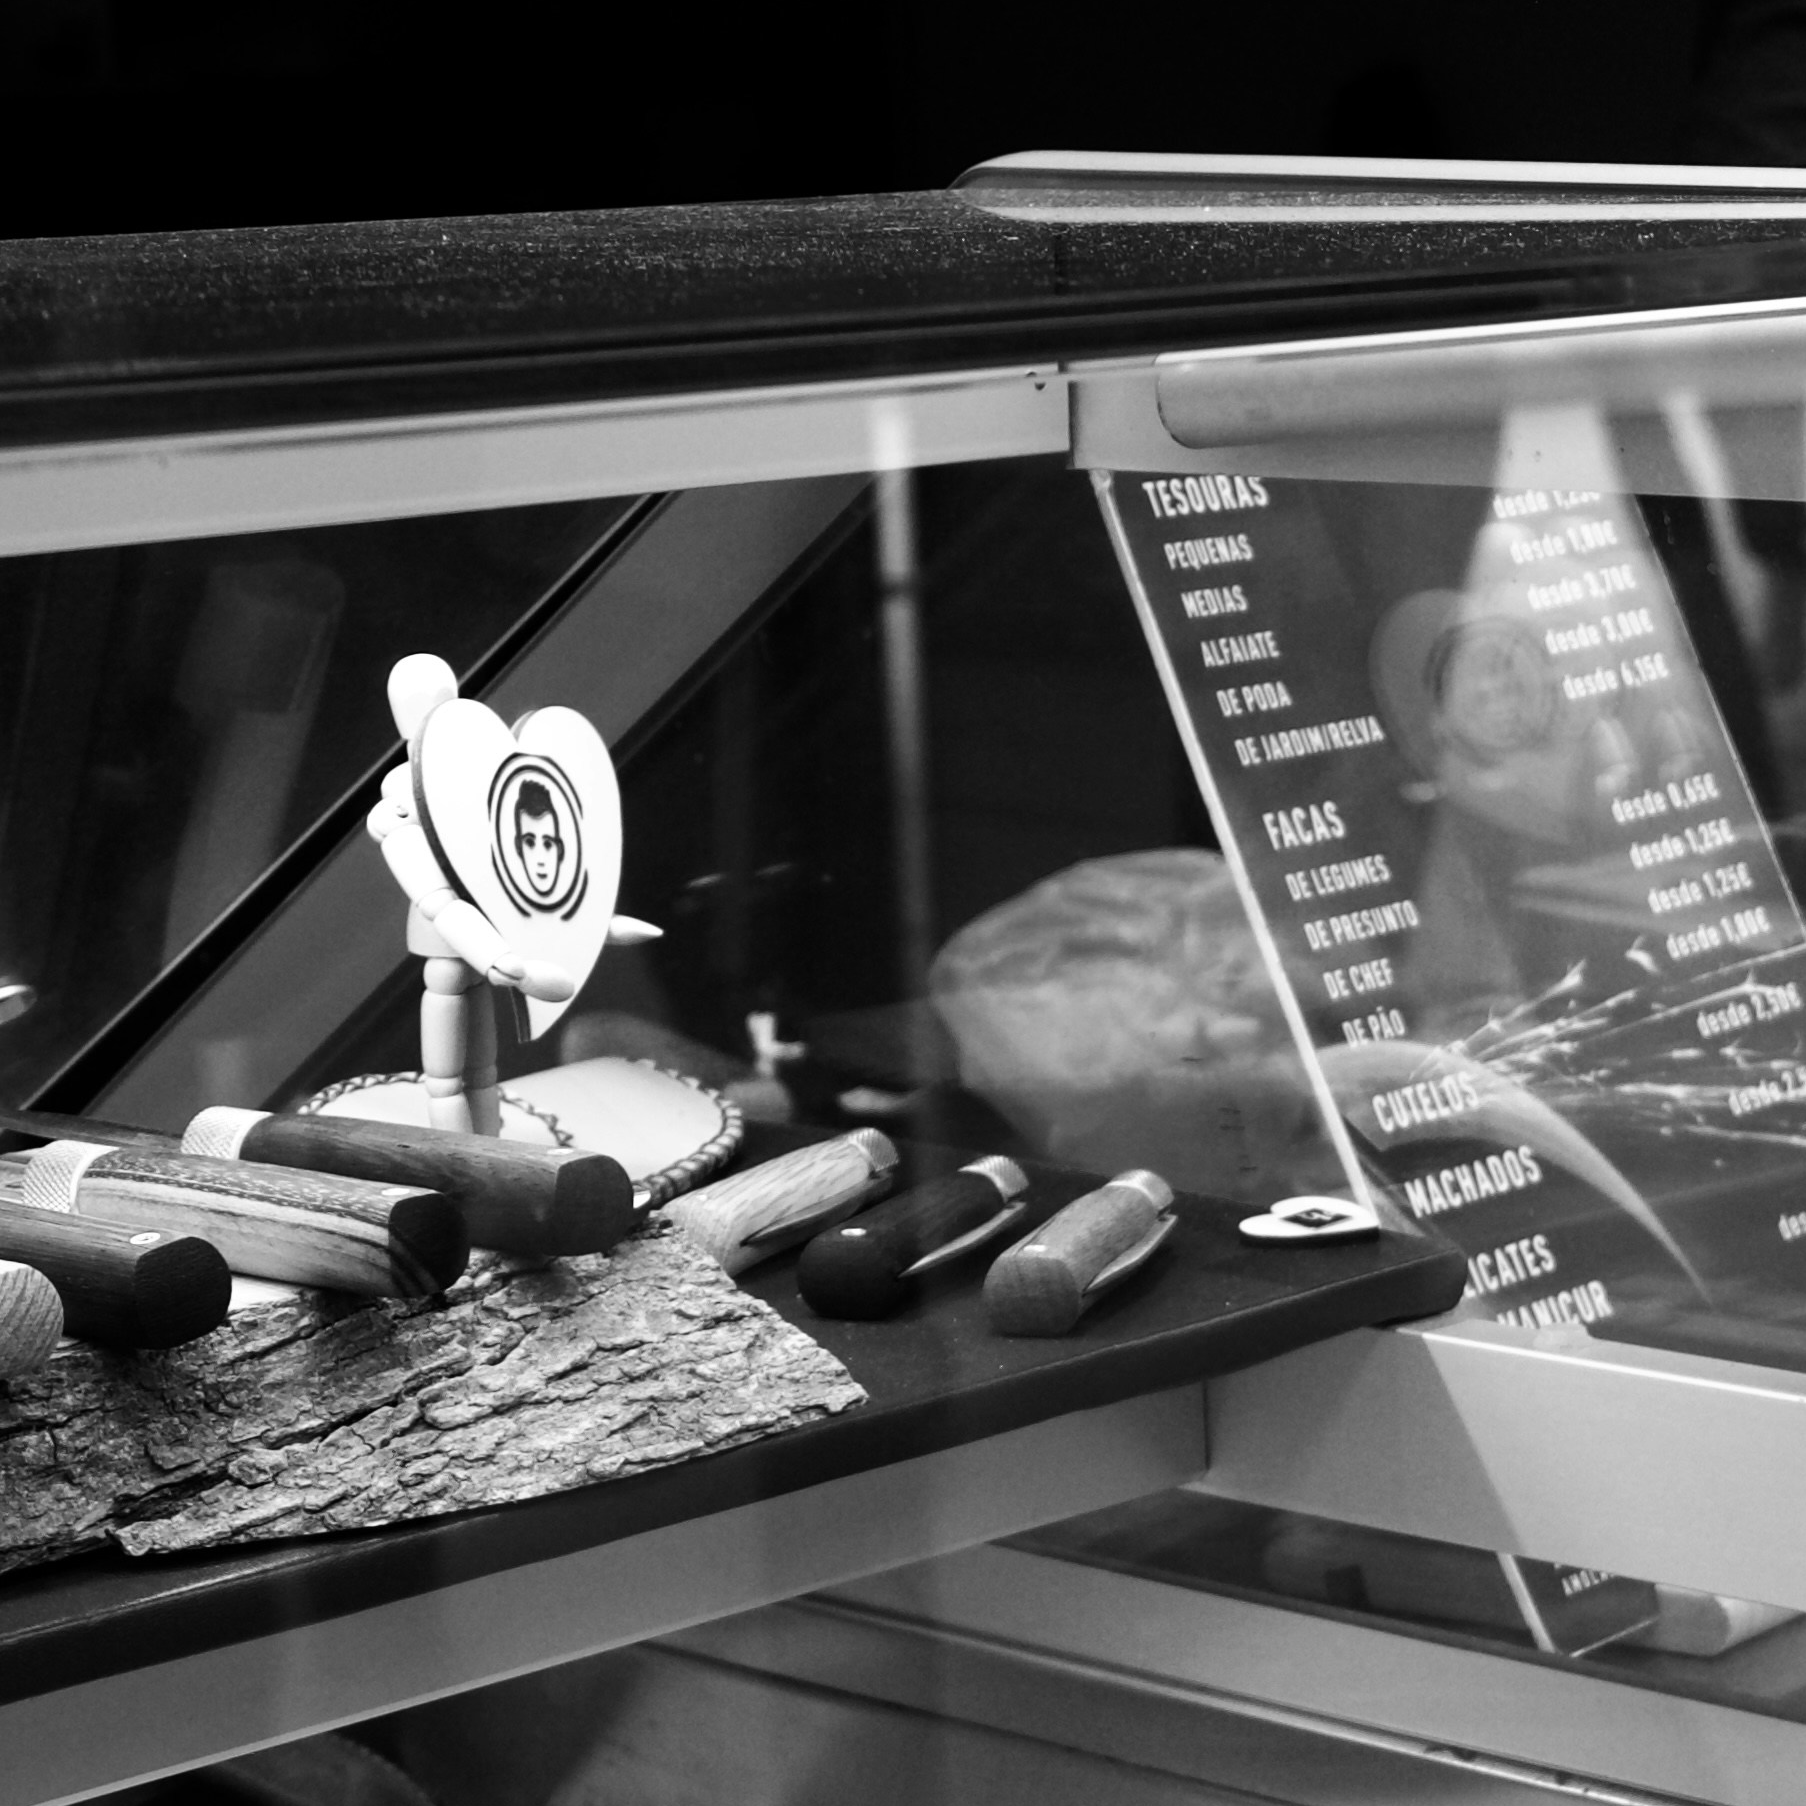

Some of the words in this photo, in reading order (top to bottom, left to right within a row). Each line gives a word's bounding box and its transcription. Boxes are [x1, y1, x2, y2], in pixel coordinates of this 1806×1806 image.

[1141, 474, 1270, 519] TESOURAS
[1493, 489, 1549, 519] desde
[1163, 533, 1254, 571] PEQUENAS
[1509, 533, 1566, 565] desde
[1180, 584, 1248, 619] MEDIAS
[1527, 578, 1584, 611] desde
[1200, 630, 1281, 668] ALFAIATE
[1545, 621, 1601, 655] desde
[1215, 687, 1244, 717] DE
[1241, 680, 1293, 712] PODA
[1562, 666, 1618, 701] desde
[1234, 736, 1262, 767] DE
[1260, 714, 1387, 762] JARDIM/RELVA
[1262, 799, 1346, 852] FACAS
[1611, 789, 1667, 824] desde
[1629, 833, 1686, 870] desde
[1684, 816, 1735, 854] 1,25€
[1284, 870, 1313, 902] DE
[1310, 853, 1392, 897] LEGUMES
[1648, 878, 1703, 914] desde
[1702, 861, 1753, 899] 1,25€
[1303, 919, 1332, 951] DE
[1329, 898, 1420, 945] PRESUNTO
[1666, 923, 1721, 961] desde
[1322, 968, 1350, 1001] DE
[1348, 957, 1394, 994] CHEF
[1696, 1001, 1751, 1039] desde
[1751, 981, 1802, 1021] 2,50€
[1341, 1017, 1369, 1048] DE
[1371, 1070, 1480, 1134] CUTELOS
[1728, 1079, 1782, 1117] desde
[1404, 1144, 1543, 1220] MACHADOS
